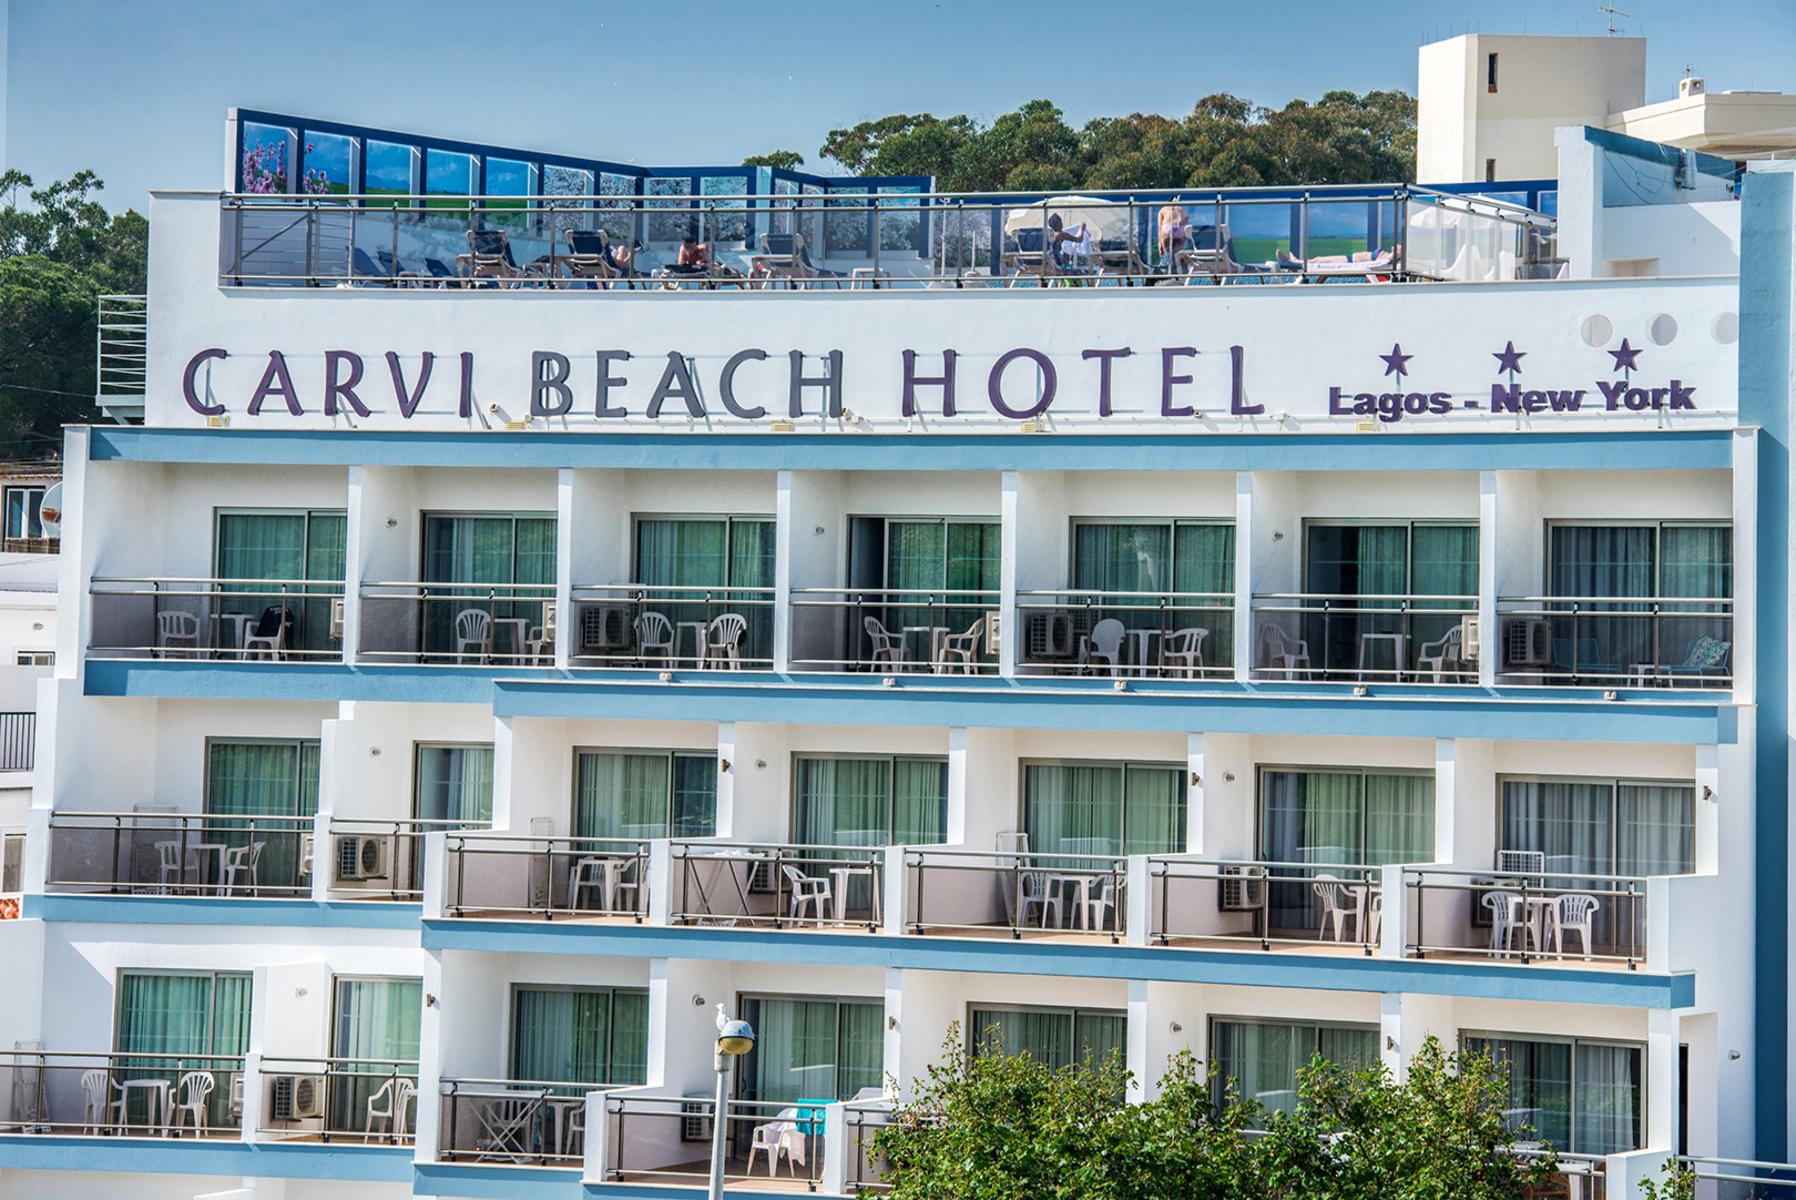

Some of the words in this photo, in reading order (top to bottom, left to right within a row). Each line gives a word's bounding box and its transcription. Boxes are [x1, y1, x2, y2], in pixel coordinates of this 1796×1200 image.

[183, 348, 473, 419] CARVI
[530, 349, 844, 419] BEACH
[902, 345, 1265, 419] HOTEL
[1328, 386, 1453, 423] Lagos
[1490, 383, 1587, 414] New
[1596, 379, 1698, 411] York
